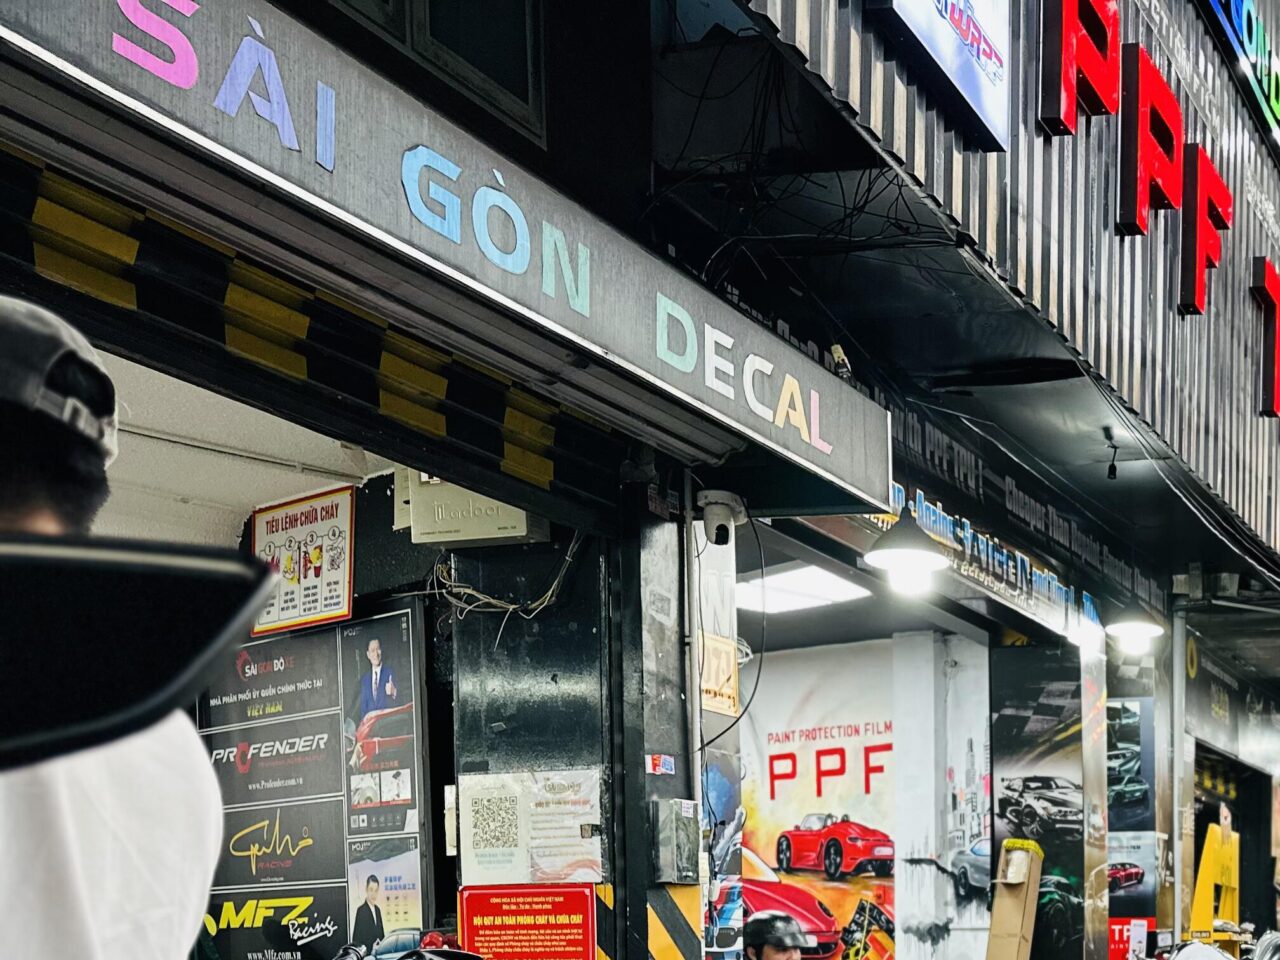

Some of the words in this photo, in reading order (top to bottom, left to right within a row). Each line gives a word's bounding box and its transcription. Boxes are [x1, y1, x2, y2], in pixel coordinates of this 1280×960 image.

[1042, 0, 1233, 315] PPF
[112, 0, 337, 173] SÀI
[400, 143, 592, 317] GÒN
[655, 293, 834, 456] DECAL
[273, 656, 285, 672] ĐỘ
[209, 694, 222, 707] NHÀ
[313, 678, 323, 691] TẠI
[767, 730, 796, 745] PAINT
[799, 724, 860, 742] PROTECTION
[864, 720, 893, 736] FILM
[211, 733, 329, 774] PROFENDER
[768, 743, 893, 800] PPF
[218, 896, 314, 929] MFZ
[288, 912, 338, 942] Racing
[247, 949, 302, 960] www.Mfz.com.vn
